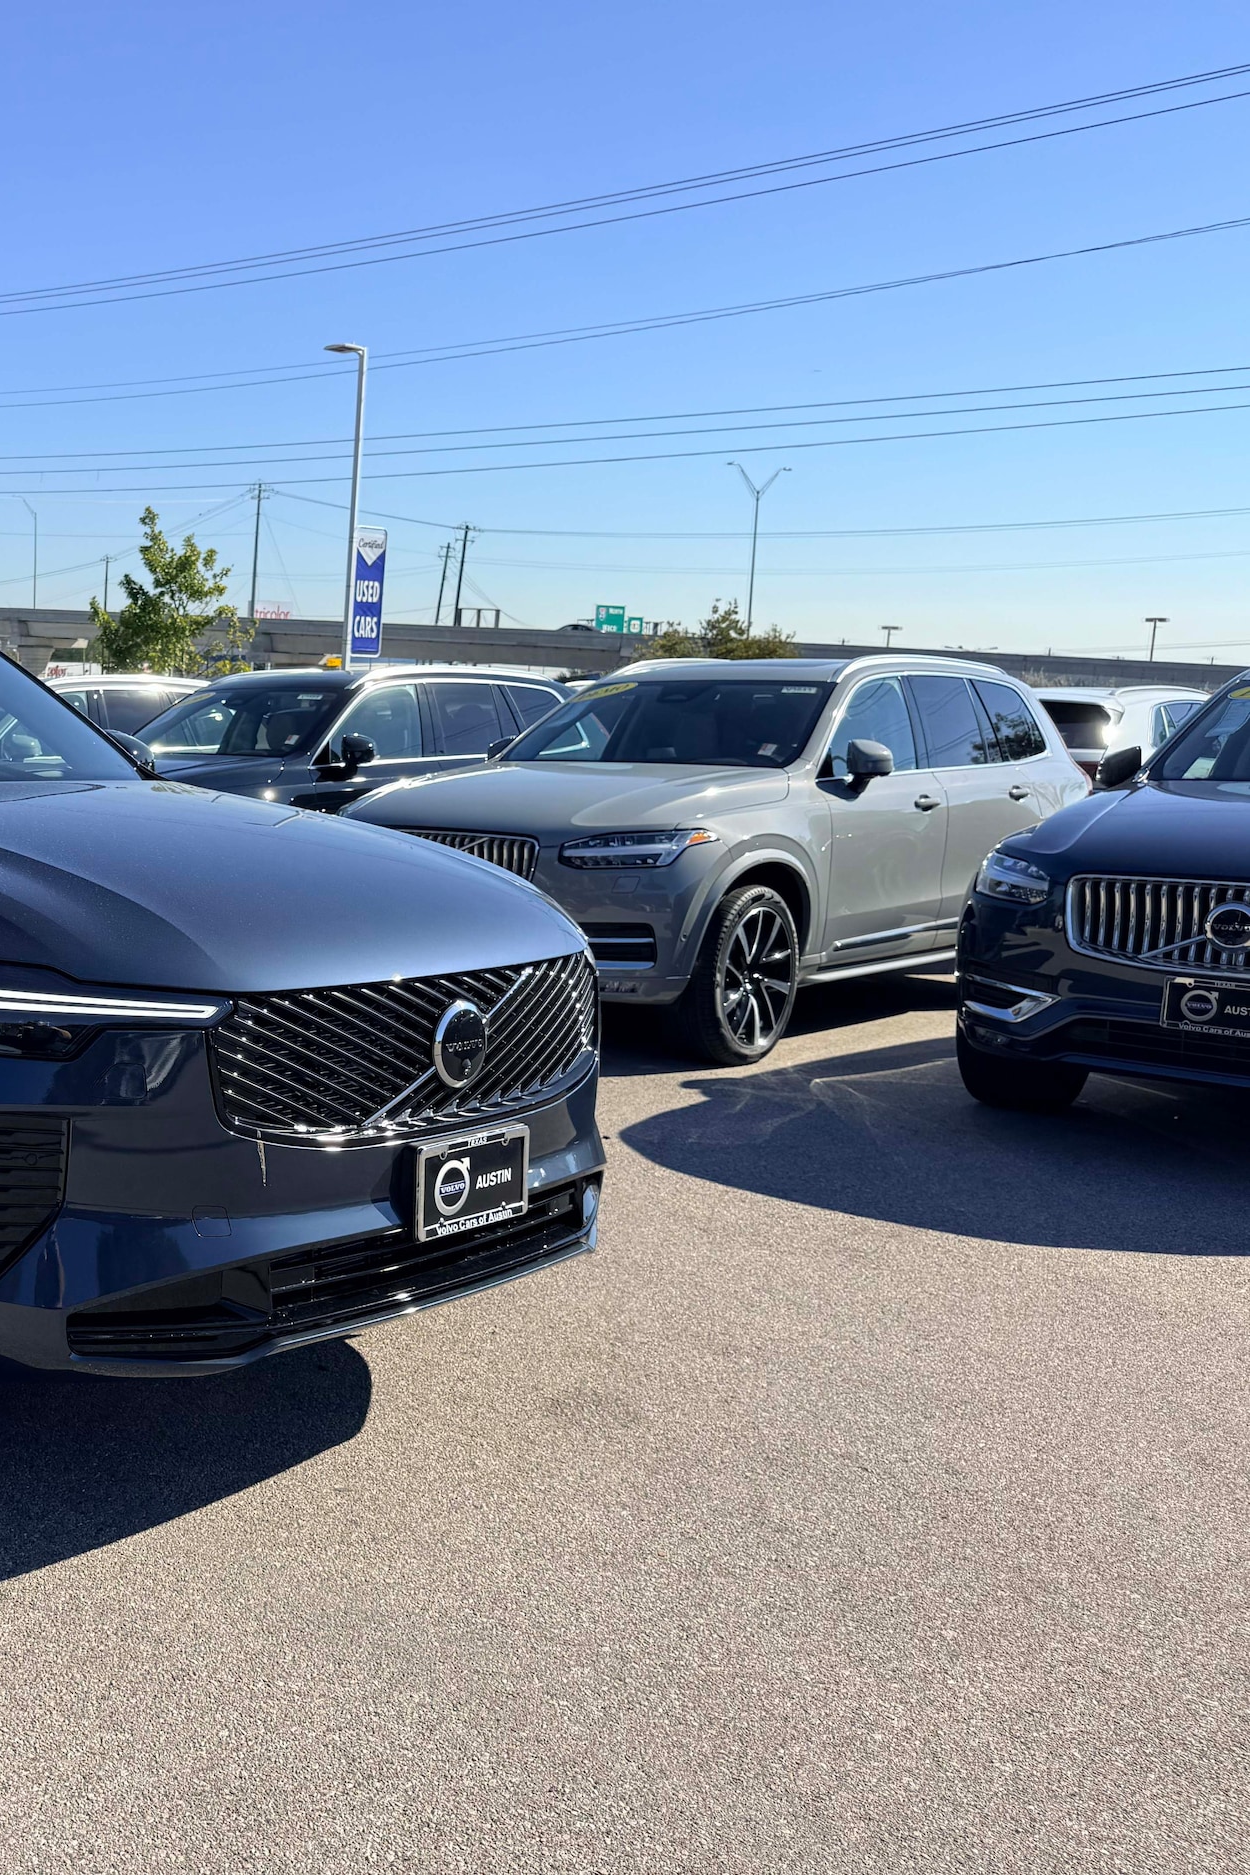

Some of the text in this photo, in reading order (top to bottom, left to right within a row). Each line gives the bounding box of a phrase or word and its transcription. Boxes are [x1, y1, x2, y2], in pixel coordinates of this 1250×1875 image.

[358, 538, 384, 549] Certified
[356, 580, 380, 603] USED
[354, 616, 378, 639] CARS
[1178, 1022, 1202, 1032] Volvo
[1203, 1025, 1223, 1034] Cars
[440, 1182, 465, 1194] VOLVO
[475, 1167, 512, 1190] AUSTIN
[436, 1208, 513, 1235] Volvo Cars of Austin
